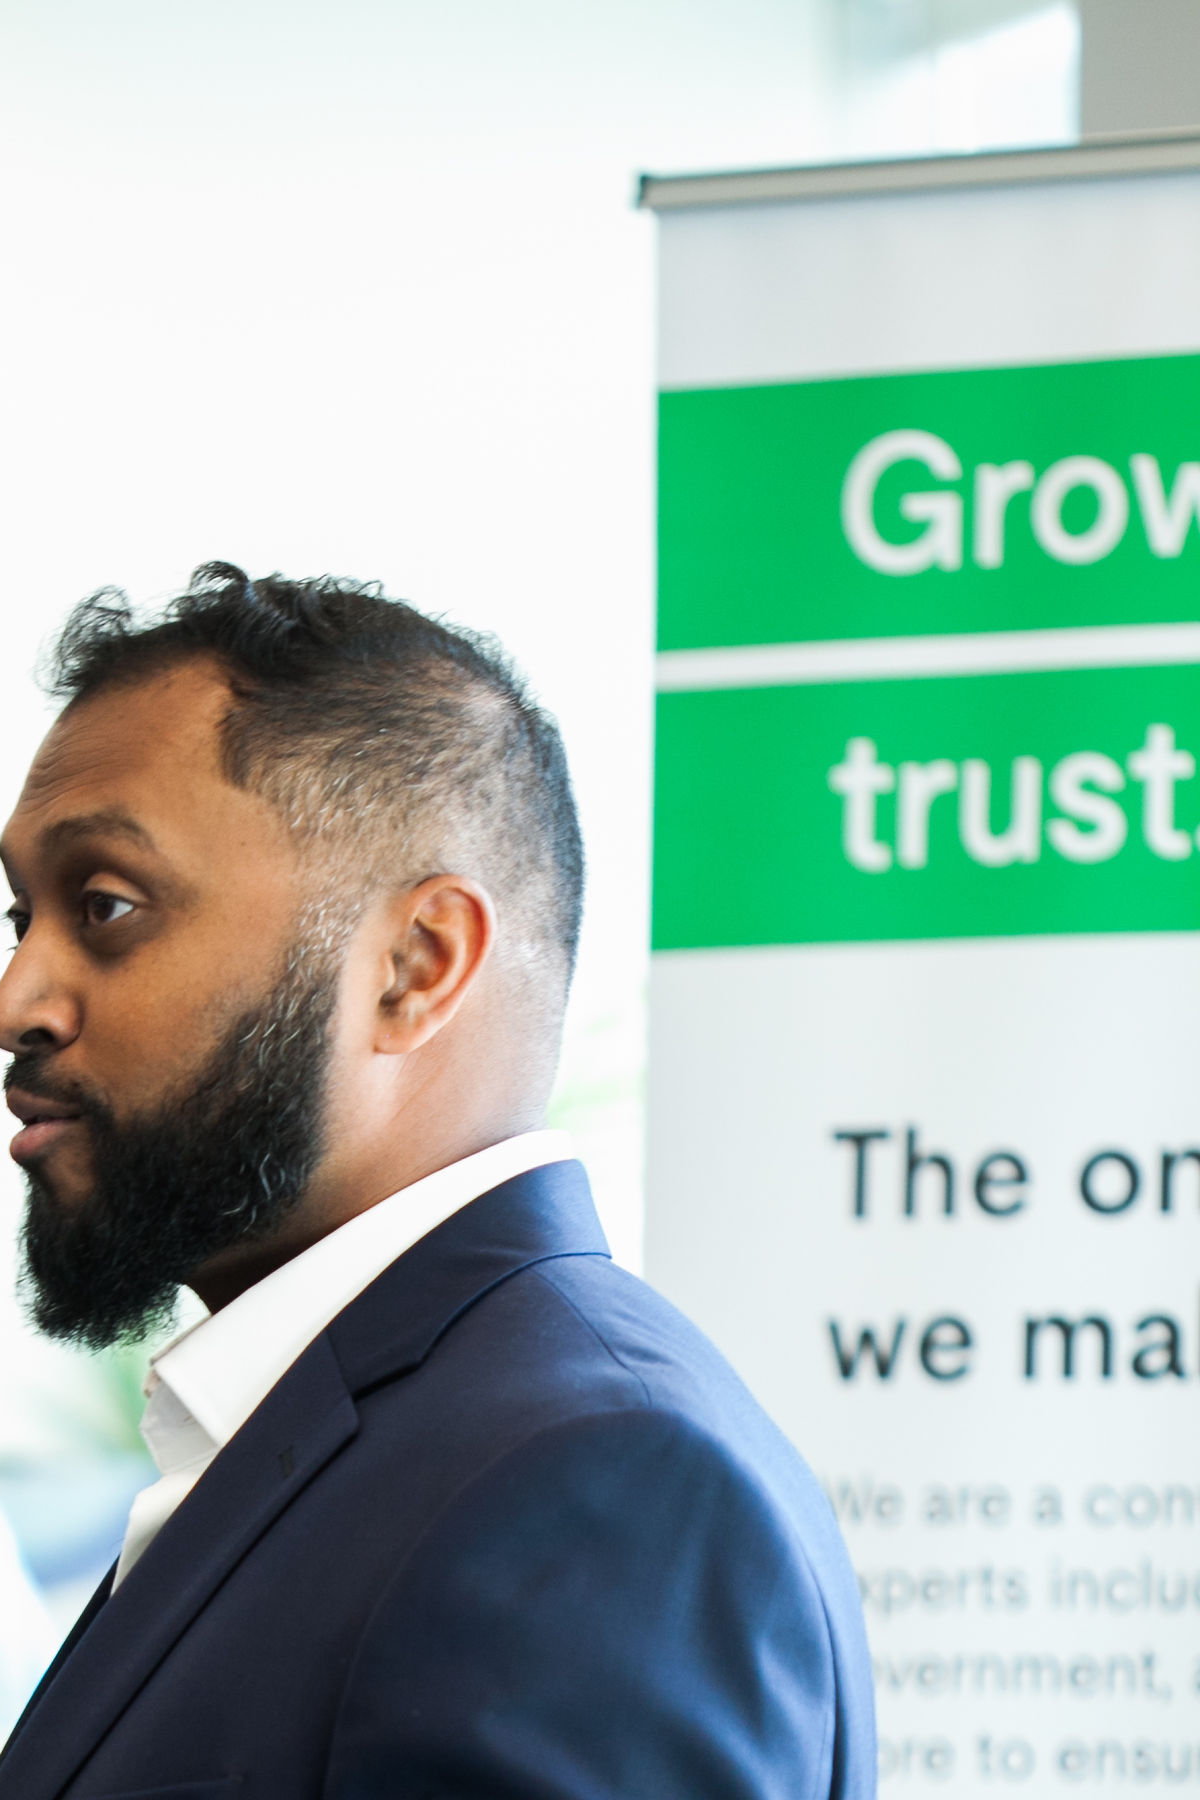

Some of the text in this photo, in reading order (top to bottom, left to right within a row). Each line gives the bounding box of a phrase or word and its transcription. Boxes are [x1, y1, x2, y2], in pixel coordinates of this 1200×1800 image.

[828, 722, 1200, 874] trust
[833, 1123, 1200, 1219] The on
[827, 1287, 1200, 1383] we ma
[924, 1482, 1013, 1527] are
[1033, 1483, 1064, 1526] a
[1050, 1554, 1200, 1613] inclu
[875, 1648, 1173, 1704] vernment,
[976, 1732, 1037, 1782] to
[1055, 1737, 1200, 1784] ensu
